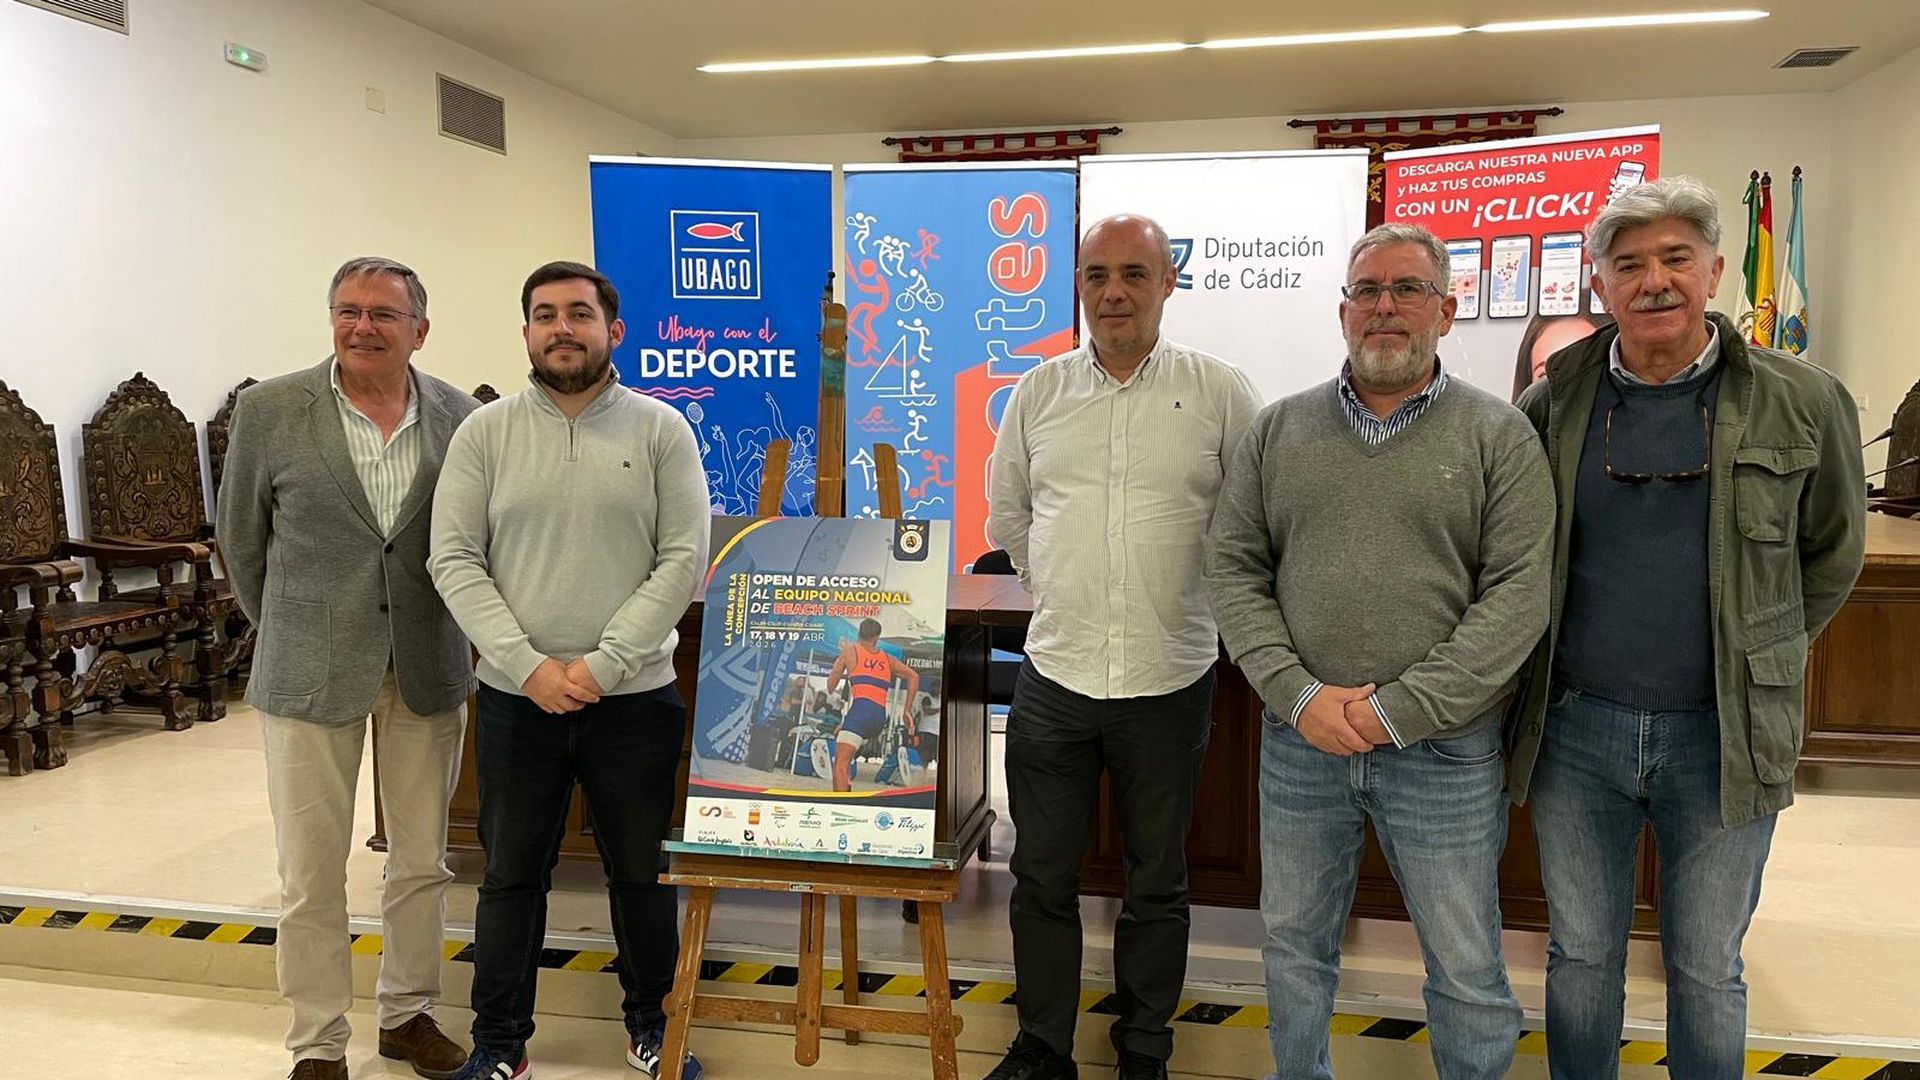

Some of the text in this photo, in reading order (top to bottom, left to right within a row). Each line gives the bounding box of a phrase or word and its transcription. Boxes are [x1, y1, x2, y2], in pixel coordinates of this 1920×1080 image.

[1398, 144, 1644, 178] DESCARGA NUESTRA NUEVA APP
[1397, 171, 1546, 198] y HAZ TUS COMPRAS
[1395, 192, 1594, 228] CON UN ¡CLICK!
[1205, 235, 1324, 262] Diputación
[681, 257, 751, 290] UBAGO
[1204, 267, 1302, 290] de Cádiz
[658, 314, 778, 354] Ubago con el
[640, 348, 797, 378] DEPORTE
[752, 574, 879, 588] OPEN DE ACCESO
[724, 573, 737, 646] LA LÍNEA DE LA
[735, 573, 747, 635] CONCEPCIÓN
[750, 588, 911, 604] AL EQUIPO NACIONAL
[750, 602, 880, 617] DE BEACH SPRINT
[750, 631, 825, 642] 17, 18 Y 19 ABR
